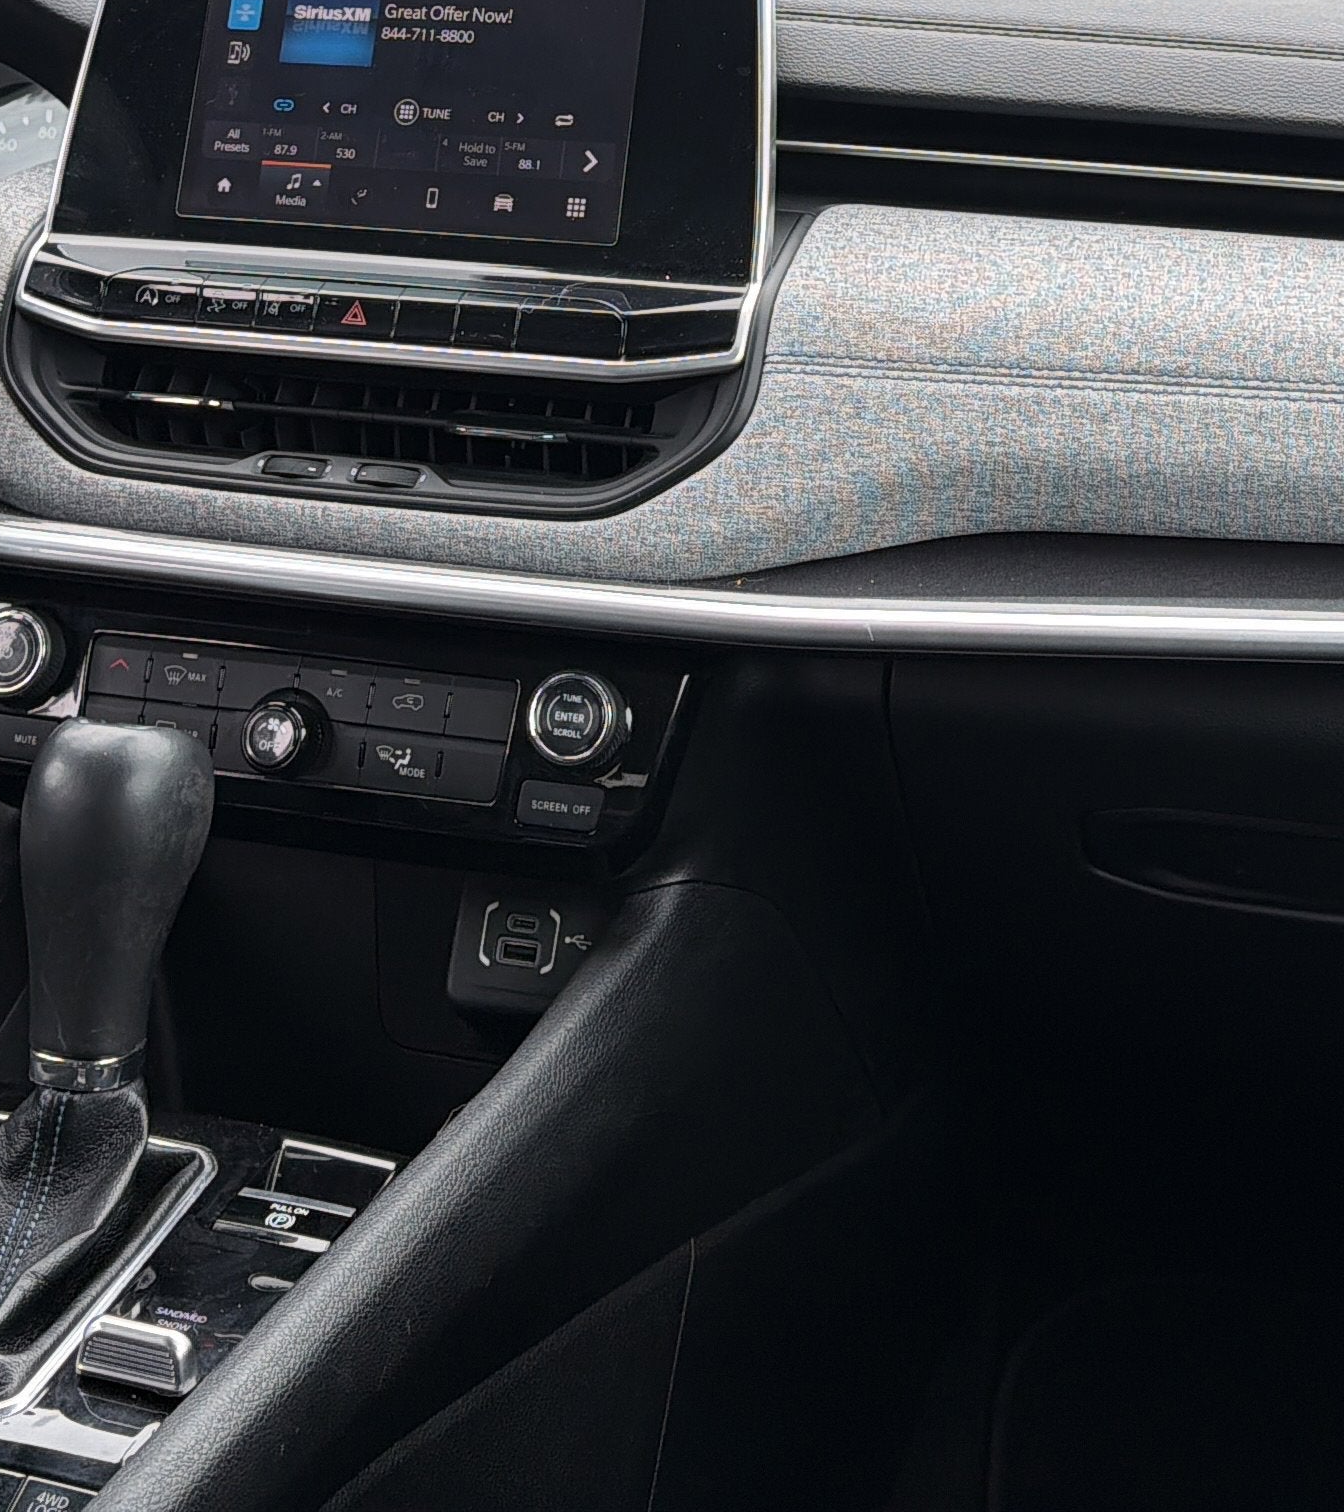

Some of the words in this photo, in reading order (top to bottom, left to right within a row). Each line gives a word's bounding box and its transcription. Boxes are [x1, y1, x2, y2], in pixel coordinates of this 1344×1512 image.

[293, 4, 372, 23] SiriusXM
[384, 3, 426, 20] Great
[429, 5, 469, 22] Offer
[471, 7, 514, 24] Now!
[381, 26, 475, 45] 844-711-8800
[340, 103, 358, 115] CH
[422, 107, 452, 120] TUNE
[487, 111, 505, 123] CH
[37, 126, 56, 139] 80
[227, 128, 241, 139] All
[213, 140, 251, 153] Presets
[273, 144, 298, 156] 87.9
[458, 141, 484, 154] Hold
[485, 144, 496, 155] to
[335, 148, 356, 159] 530
[463, 155, 488, 168] Save
[517, 158, 541, 170] 88.1
[275, 194, 306, 207] Media
[165, 294, 181, 304] OFF
[231, 301, 248, 310] OFF
[289, 303, 307, 313] OFF
[187, 672, 206, 682] MAX
[326, 686, 344, 698] A/C
[562, 692, 583, 704] TUNE
[554, 710, 585, 724] ENTER
[14, 733, 38, 746] MUTE
[552, 727, 582, 739] SCROLL
[258, 739, 281, 752] OFF
[398, 766, 426, 779] MODE
[531, 799, 568, 814] SCREEN
[572, 803, 591, 816] OFF
[269, 1202, 294, 1214] PULL
[293, 1207, 310, 1216] ON
[157, 1318, 192, 1332] SNOW
[36, 1490, 70, 1510] 4WD
